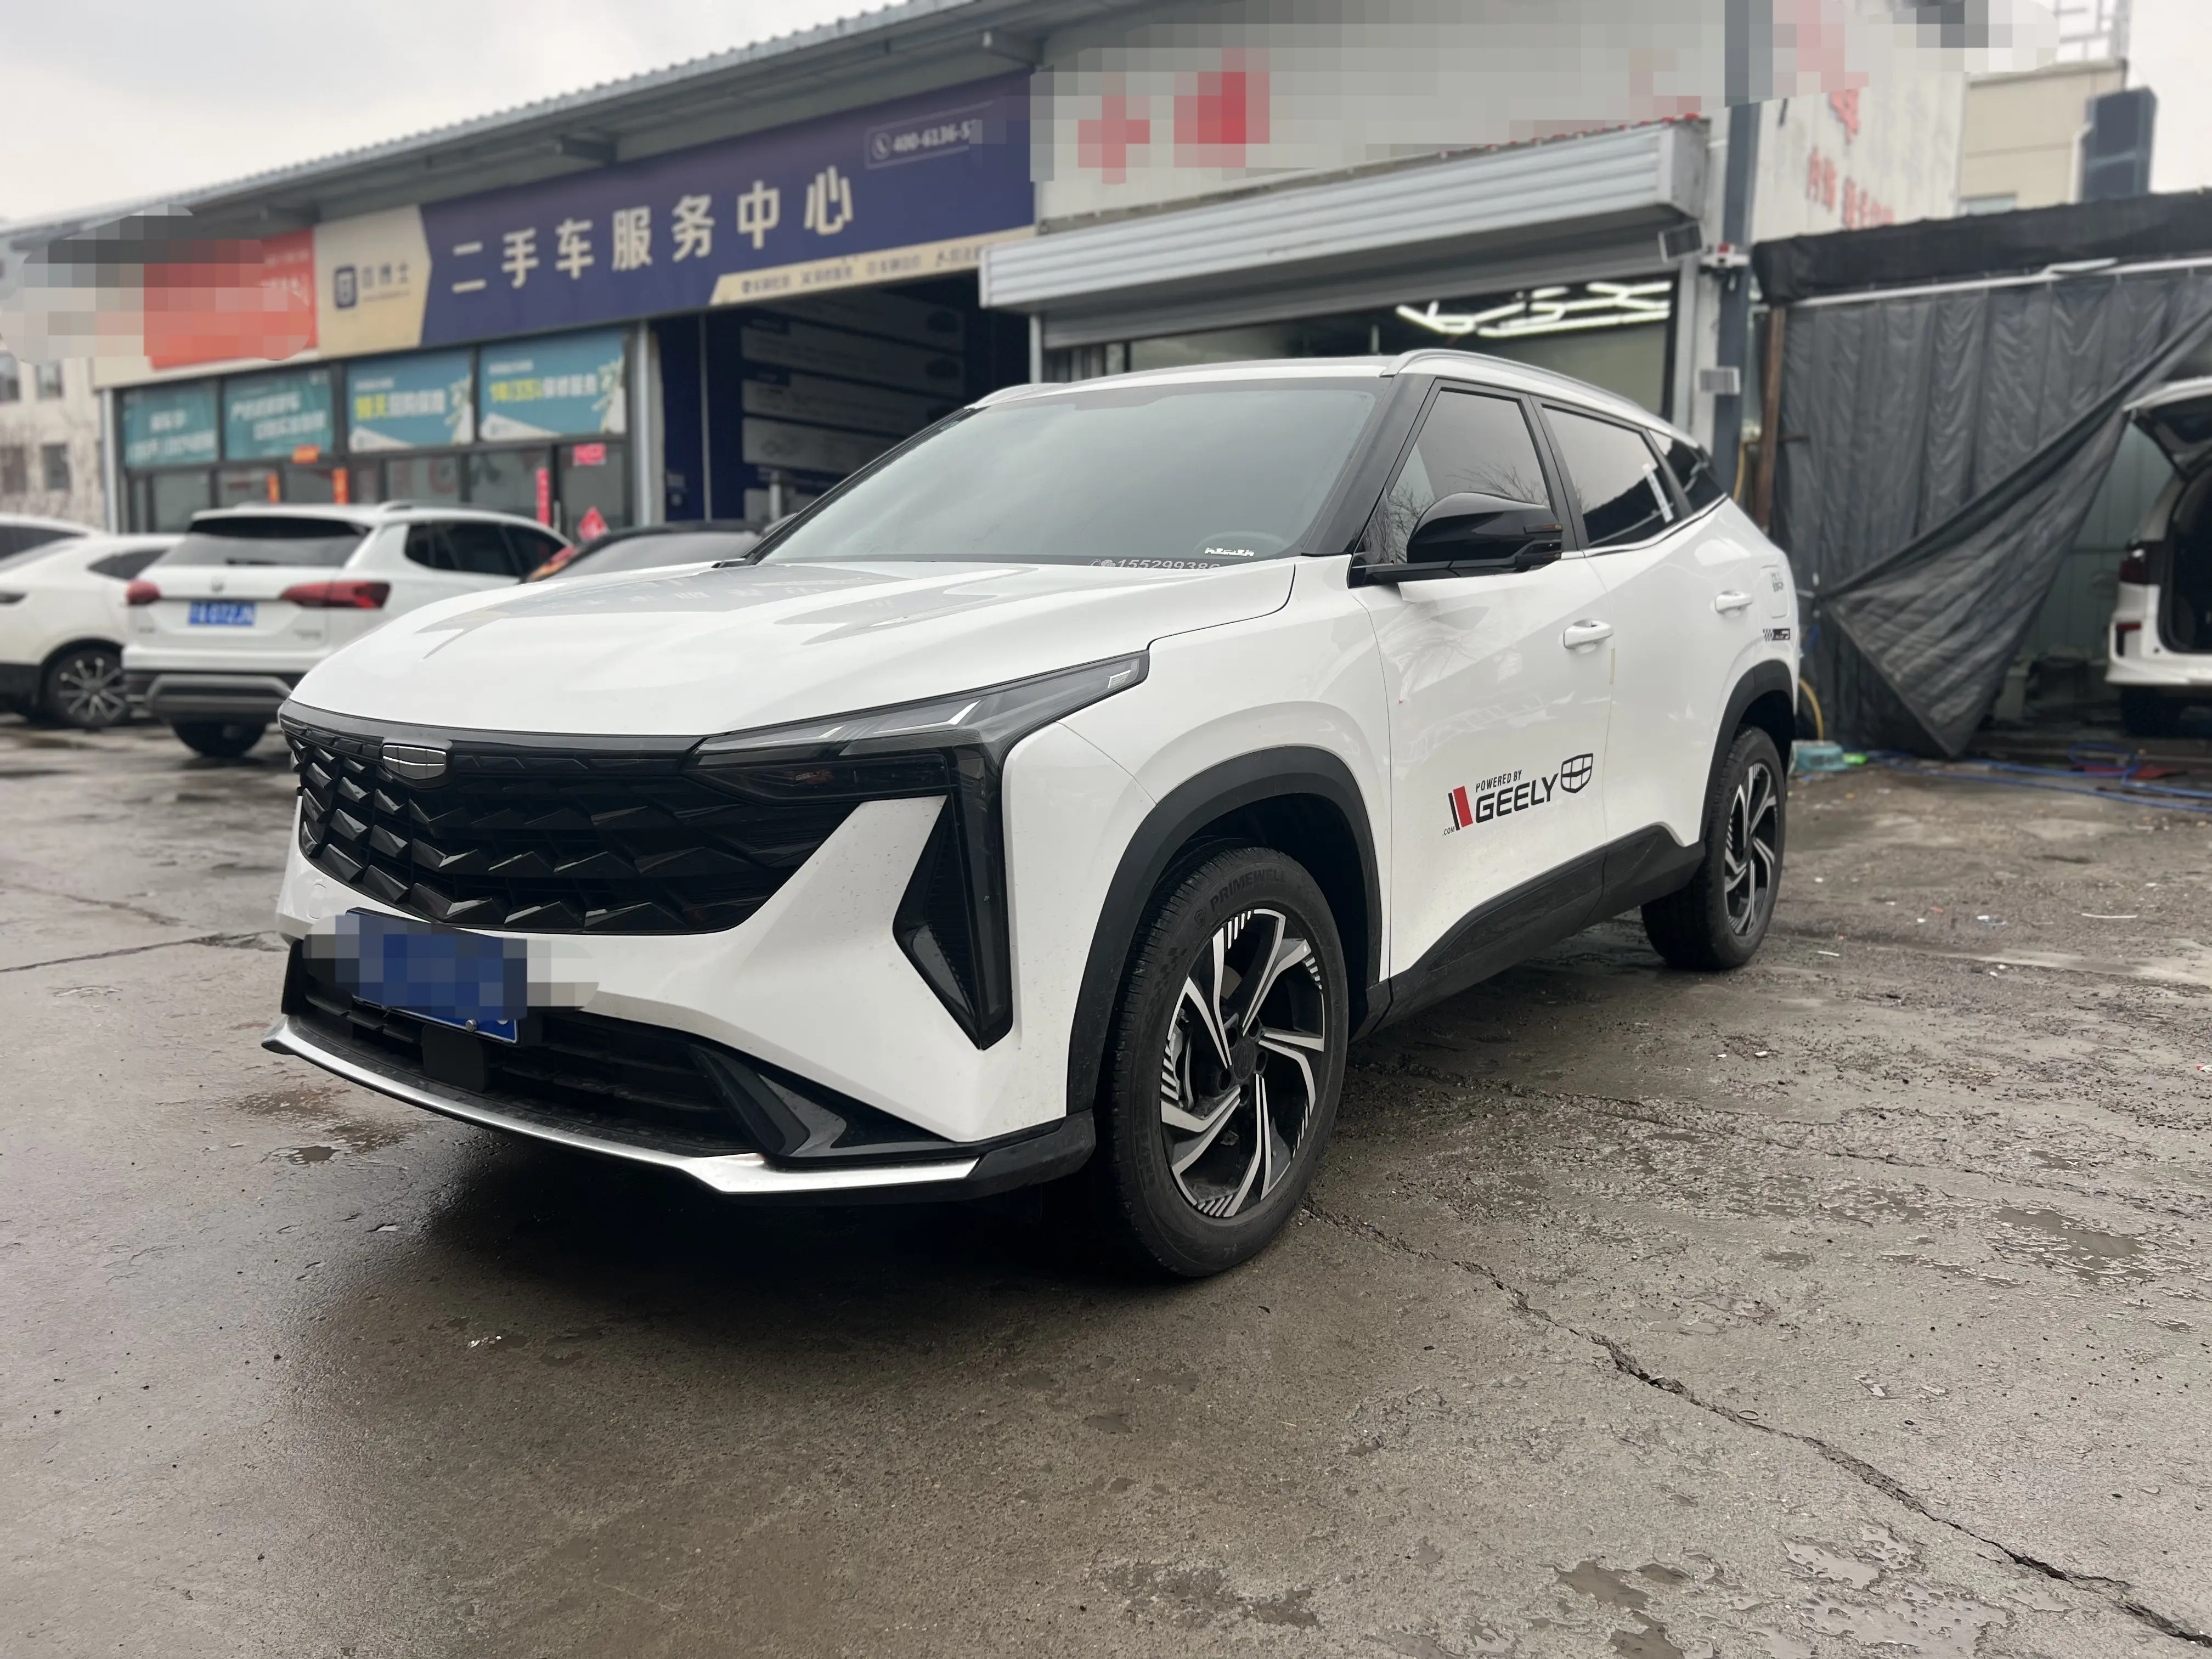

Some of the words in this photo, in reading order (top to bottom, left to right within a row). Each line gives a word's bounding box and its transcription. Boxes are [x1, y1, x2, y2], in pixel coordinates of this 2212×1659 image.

[452, 165, 854, 294] 二手车服务中心
[1475, 772, 1511, 793] POWERED
[1513, 769, 1522, 782] BY
[1475, 772, 1559, 823] GEELY
[1210, 868, 1288, 912] PRIMEWELL
